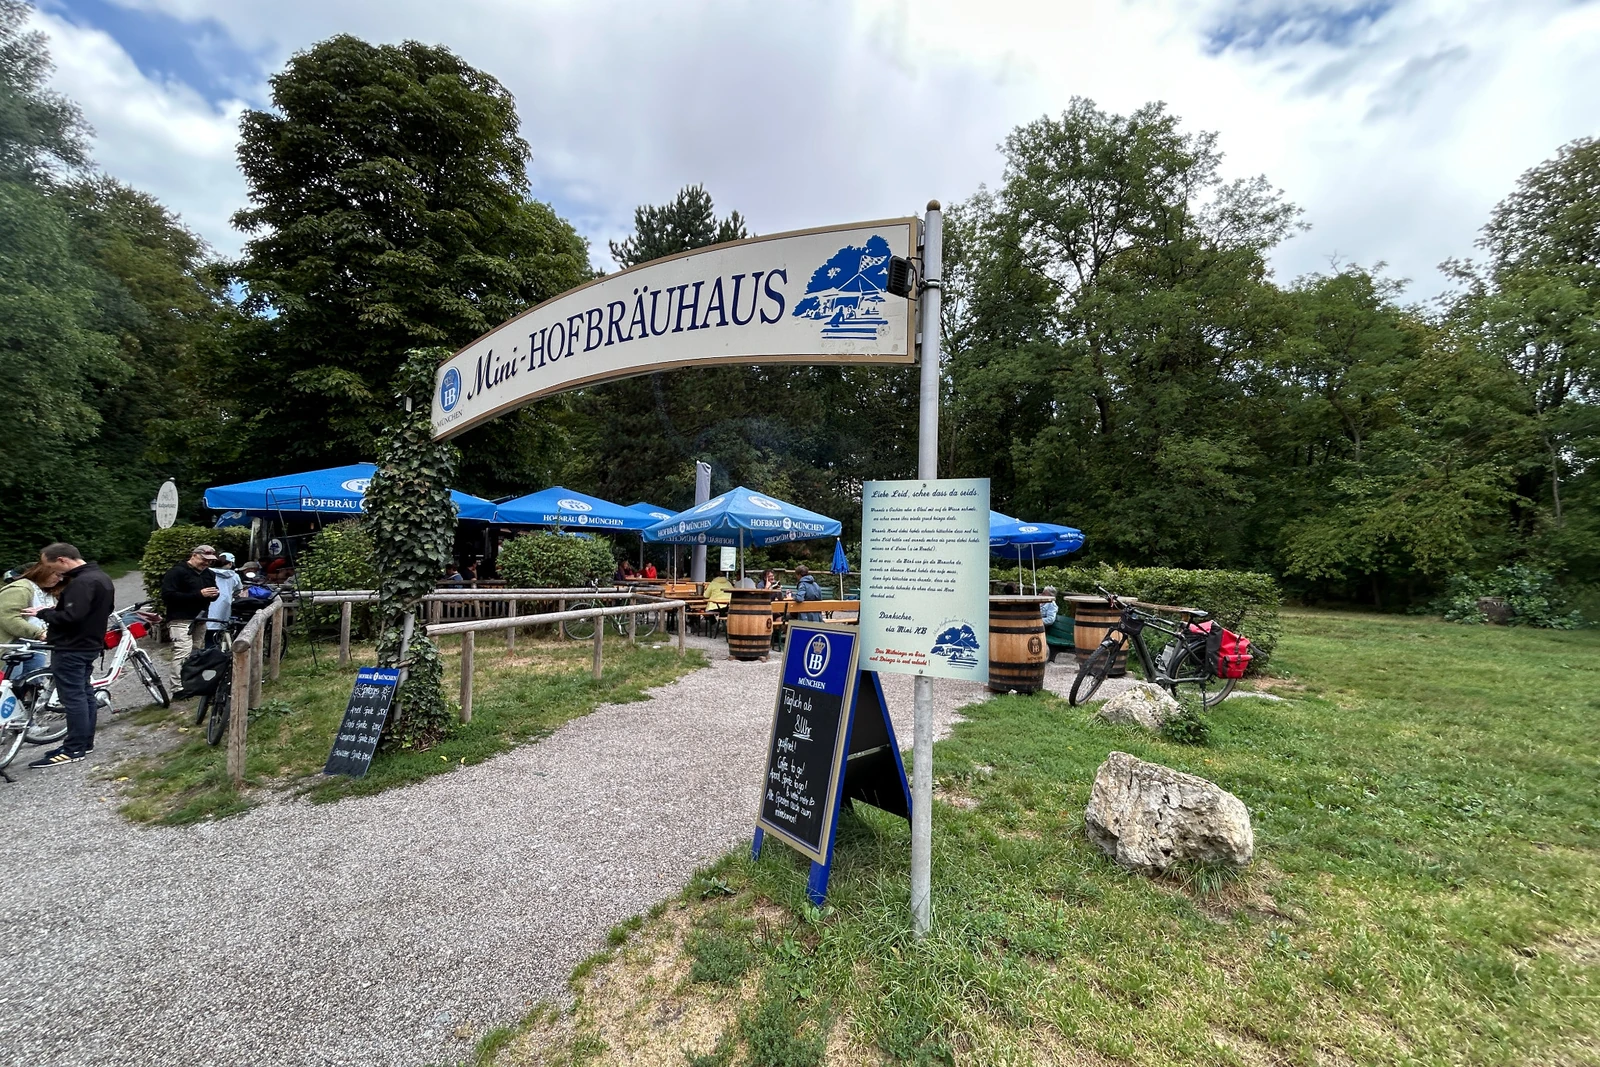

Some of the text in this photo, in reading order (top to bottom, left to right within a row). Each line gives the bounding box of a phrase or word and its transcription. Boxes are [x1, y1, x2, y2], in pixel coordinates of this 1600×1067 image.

[444, 388, 456, 407] HB
[437, 410, 463, 426] MÜNCHEN
[871, 490, 889, 498] Liebe
[912, 489, 930, 497] schee
[960, 488, 979, 496] seids.
[302, 499, 357, 509] HOFBRÄU
[589, 518, 624, 526] MÜNCHEN
[751, 519, 782, 527] HOFBRÄU
[792, 521, 824, 531] MÜNCHEN
[658, 523, 678, 537] HOFBRÄU
[686, 520, 712, 531] MÜNCHEN
[896, 626, 912, 634] Mini
[914, 626, 927, 634] HB
[809, 654, 822, 670] HB
[798, 677, 826, 689] MÜNCHEN
